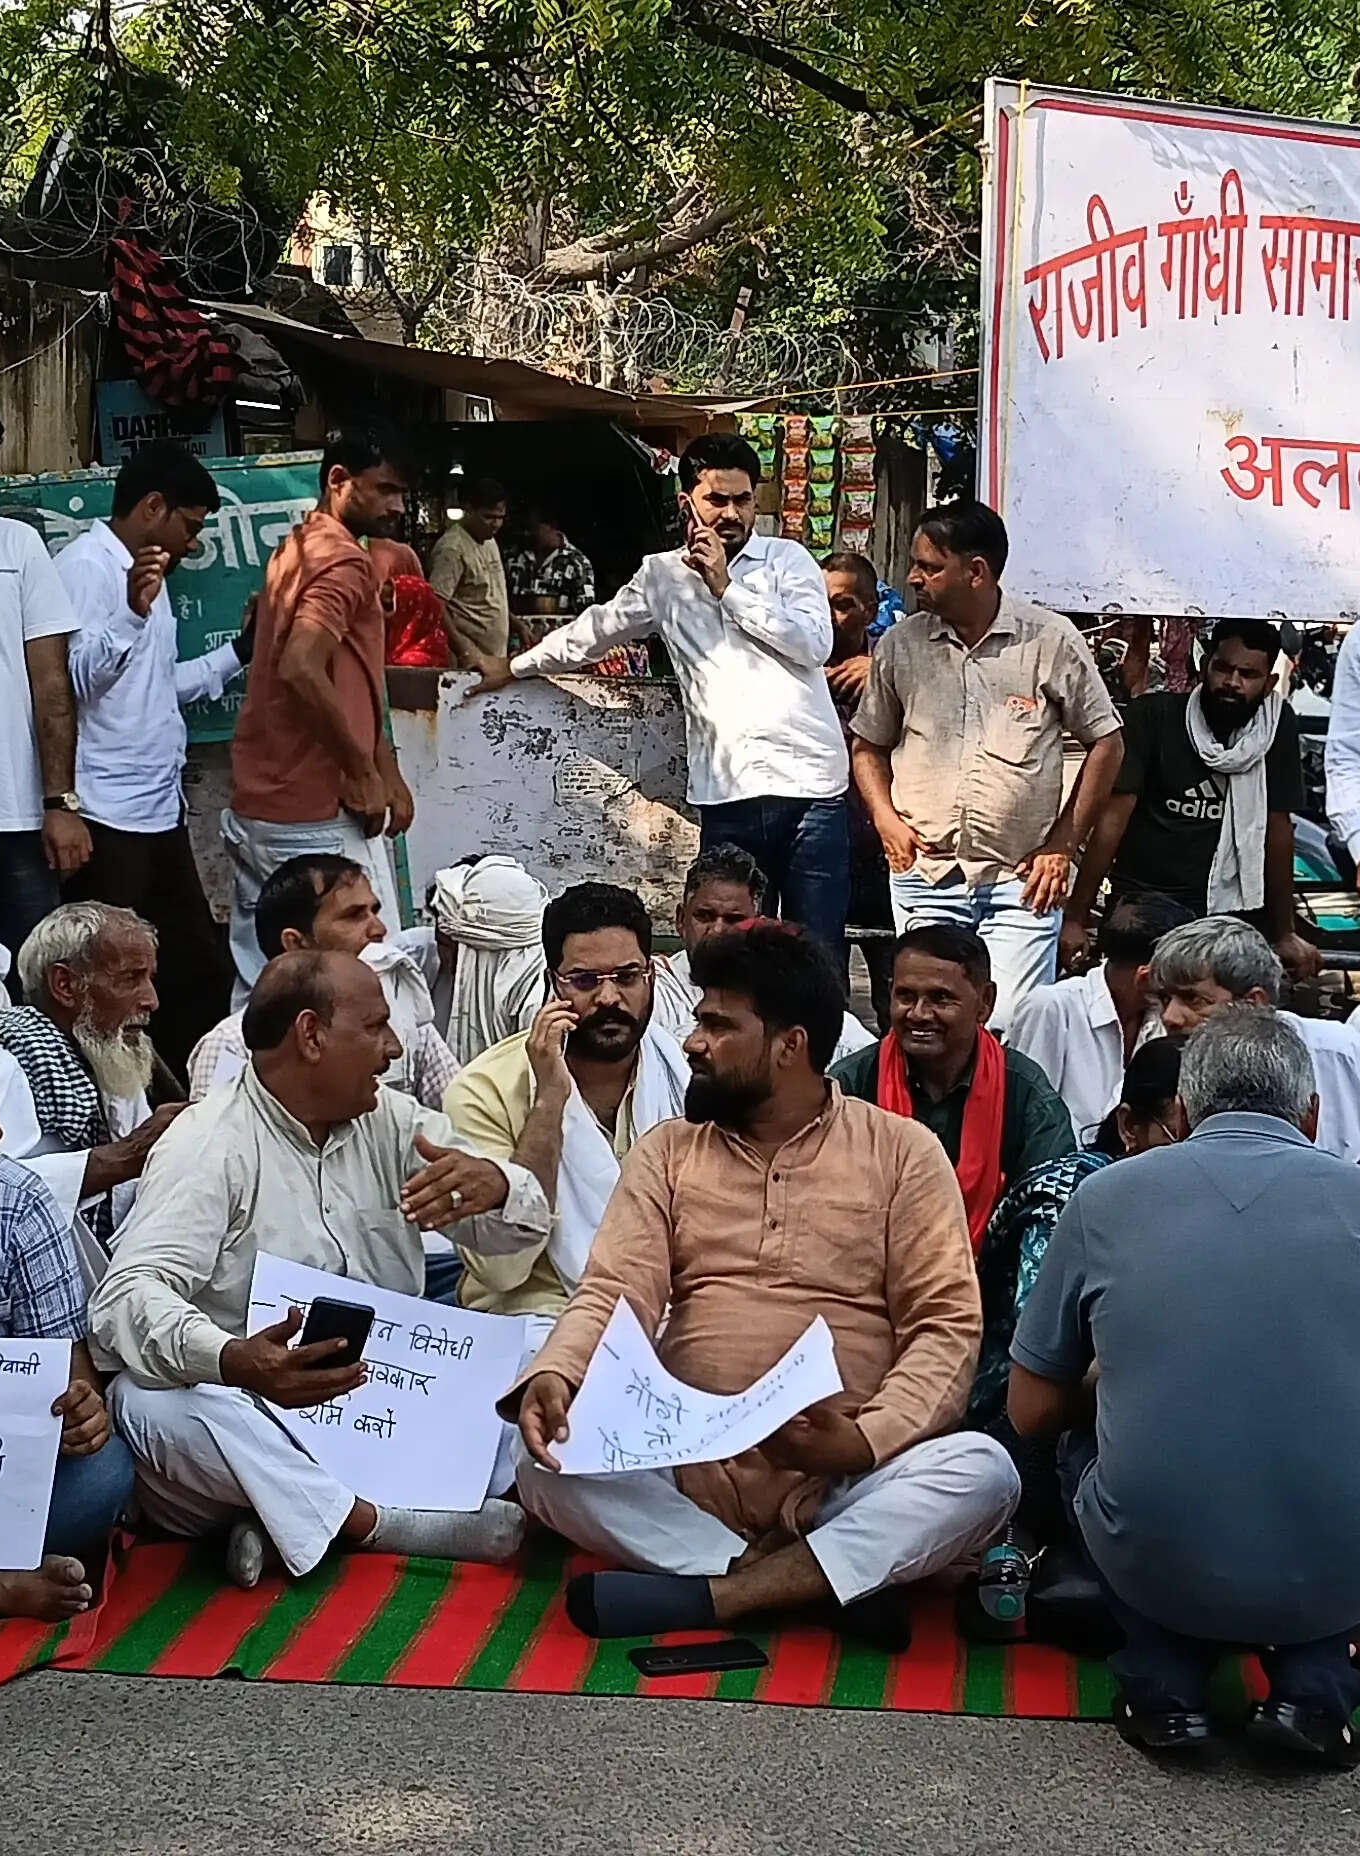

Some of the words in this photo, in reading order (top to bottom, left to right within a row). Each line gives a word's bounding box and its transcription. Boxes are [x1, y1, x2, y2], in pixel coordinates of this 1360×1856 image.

[1024, 193, 1148, 362] राजीव
[1158, 168, 1248, 320] गाँधी
[1165, 799, 1224, 820] adid
[408, 1323, 475, 1361] विरोधी
